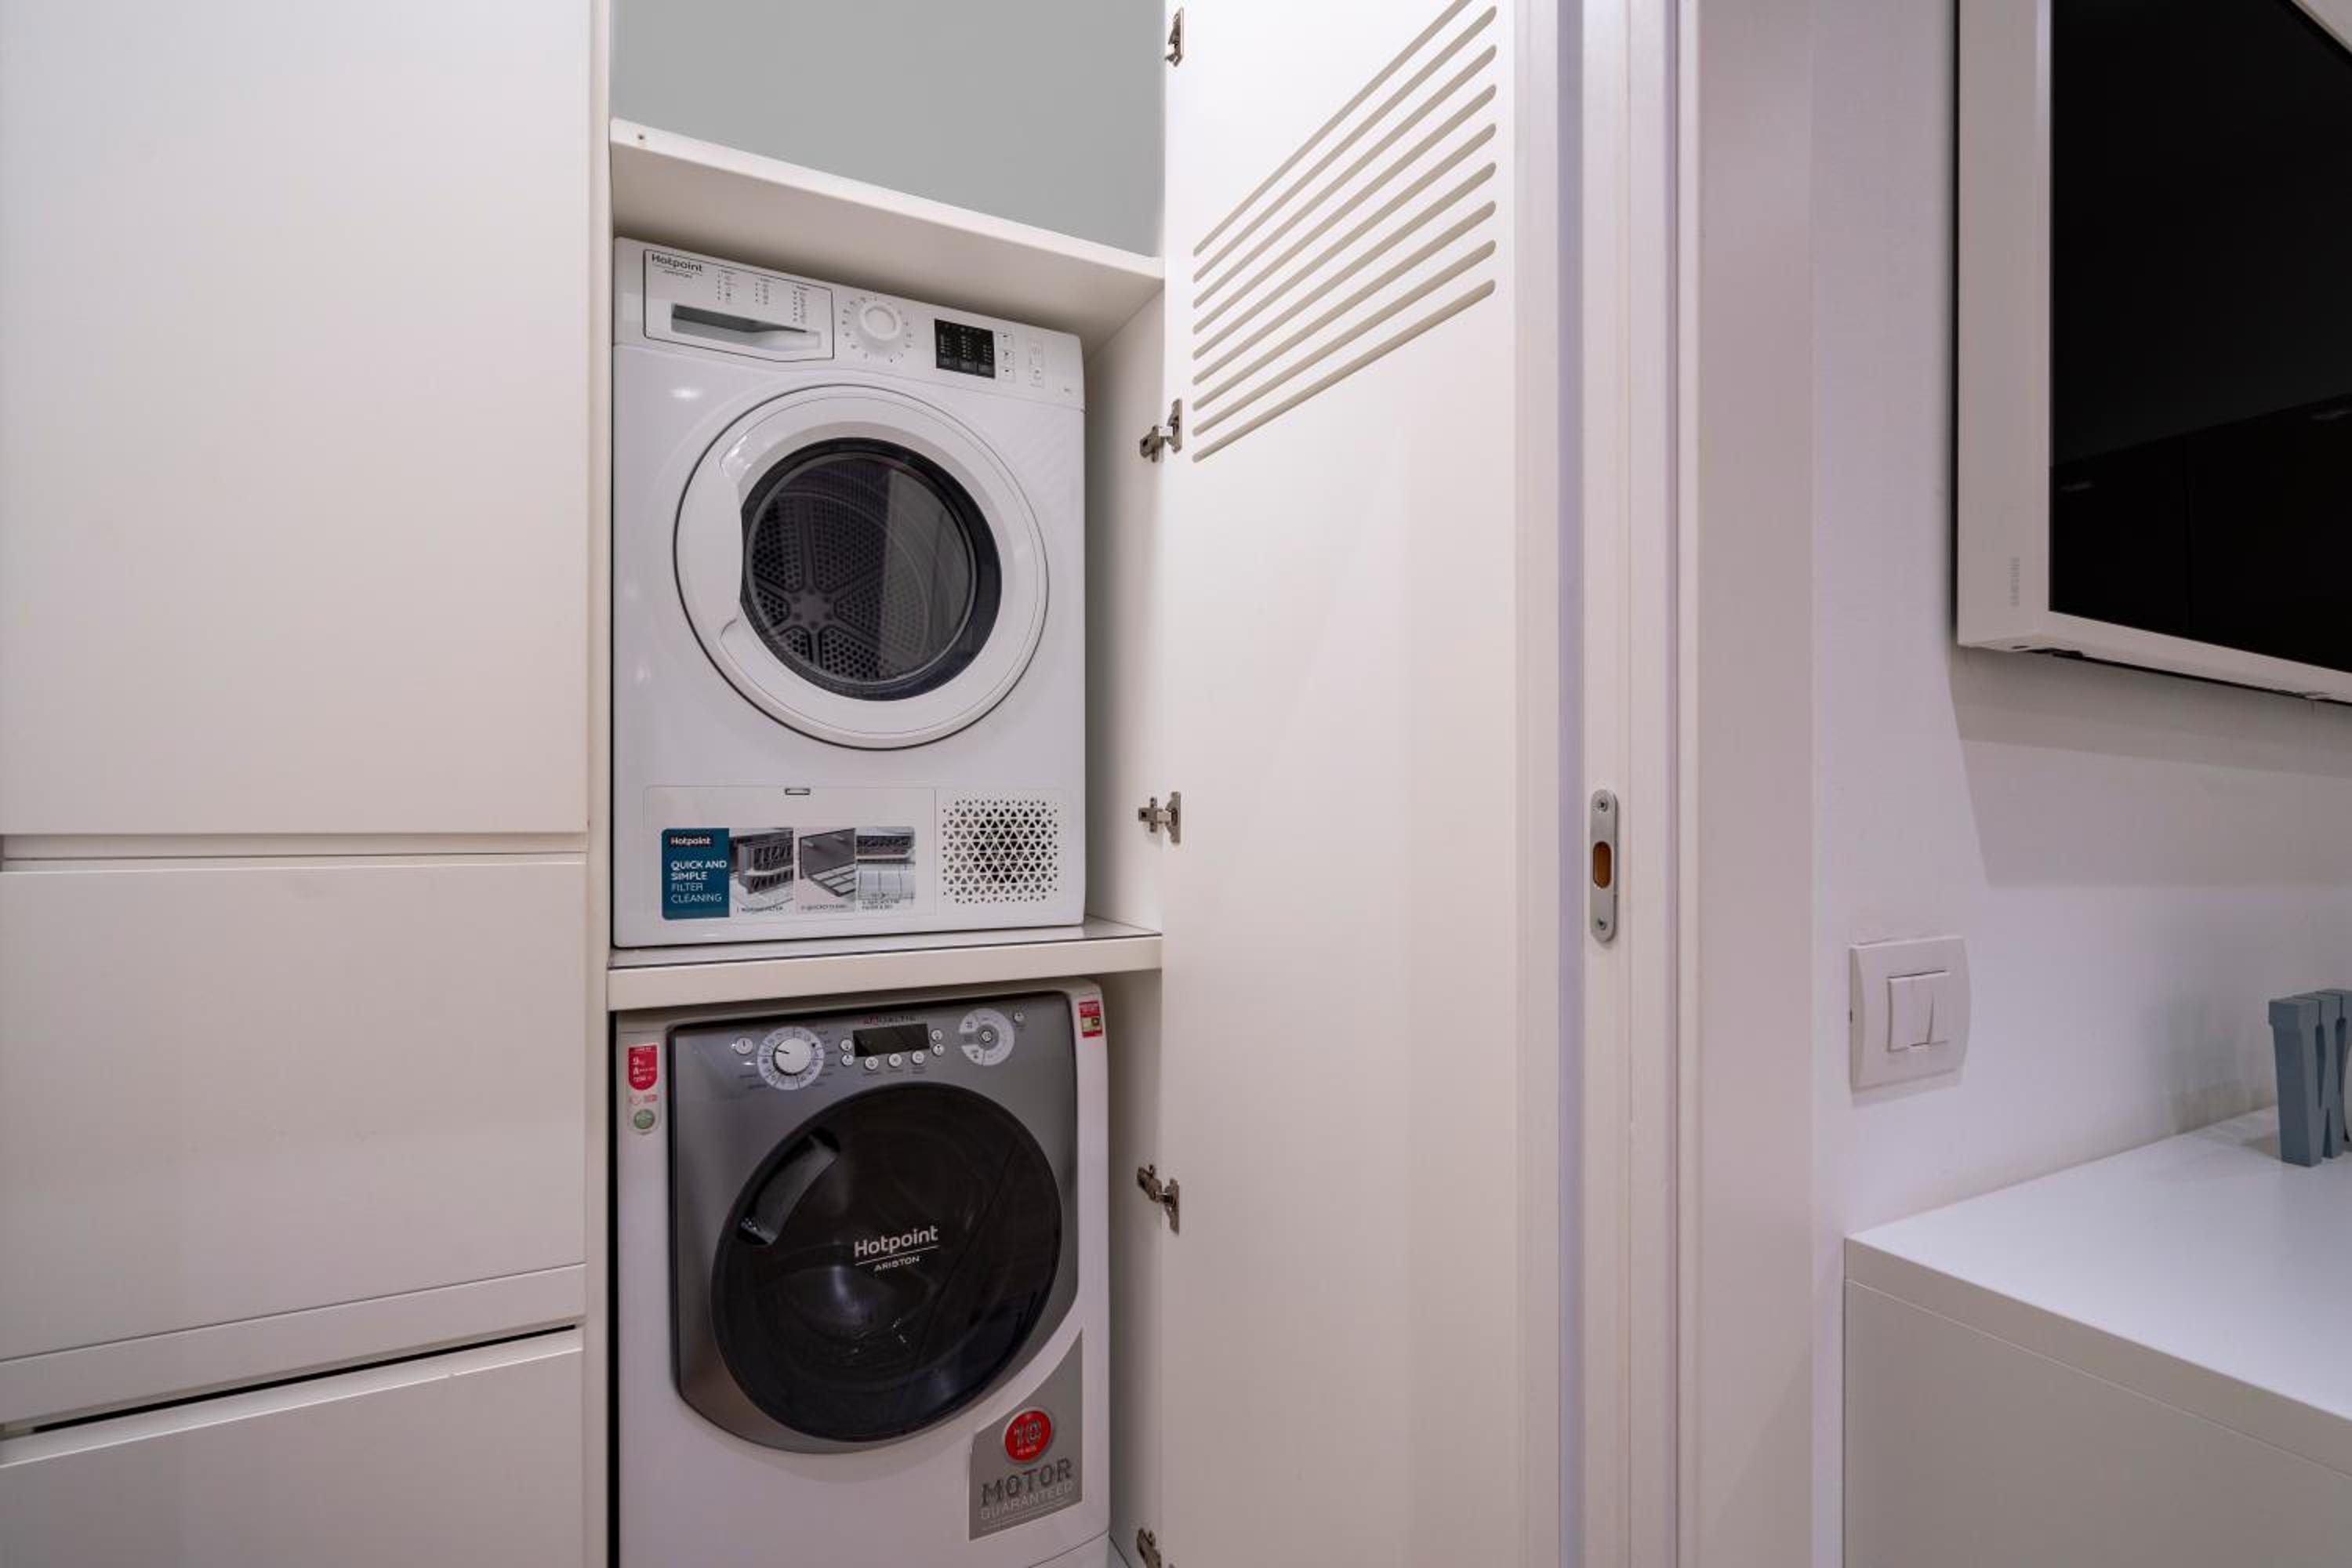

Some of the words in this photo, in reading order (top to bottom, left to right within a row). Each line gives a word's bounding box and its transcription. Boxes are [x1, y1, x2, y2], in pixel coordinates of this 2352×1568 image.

[652, 253, 702, 271] Hotpoint
[670, 837, 711, 846] Hotpoint
[670, 860, 703, 871] QUICK
[706, 859, 728, 869] AND
[671, 871, 708, 880] SIMPLE
[671, 882, 704, 891] FILTER
[670, 893, 723, 903] CLEANING
[854, 1225, 938, 1258] Hotpoint
[874, 1255, 920, 1272] ARISTON
[982, 1457, 1072, 1506] MOTOR
[981, 1479, 1074, 1520] GUARANTEED
